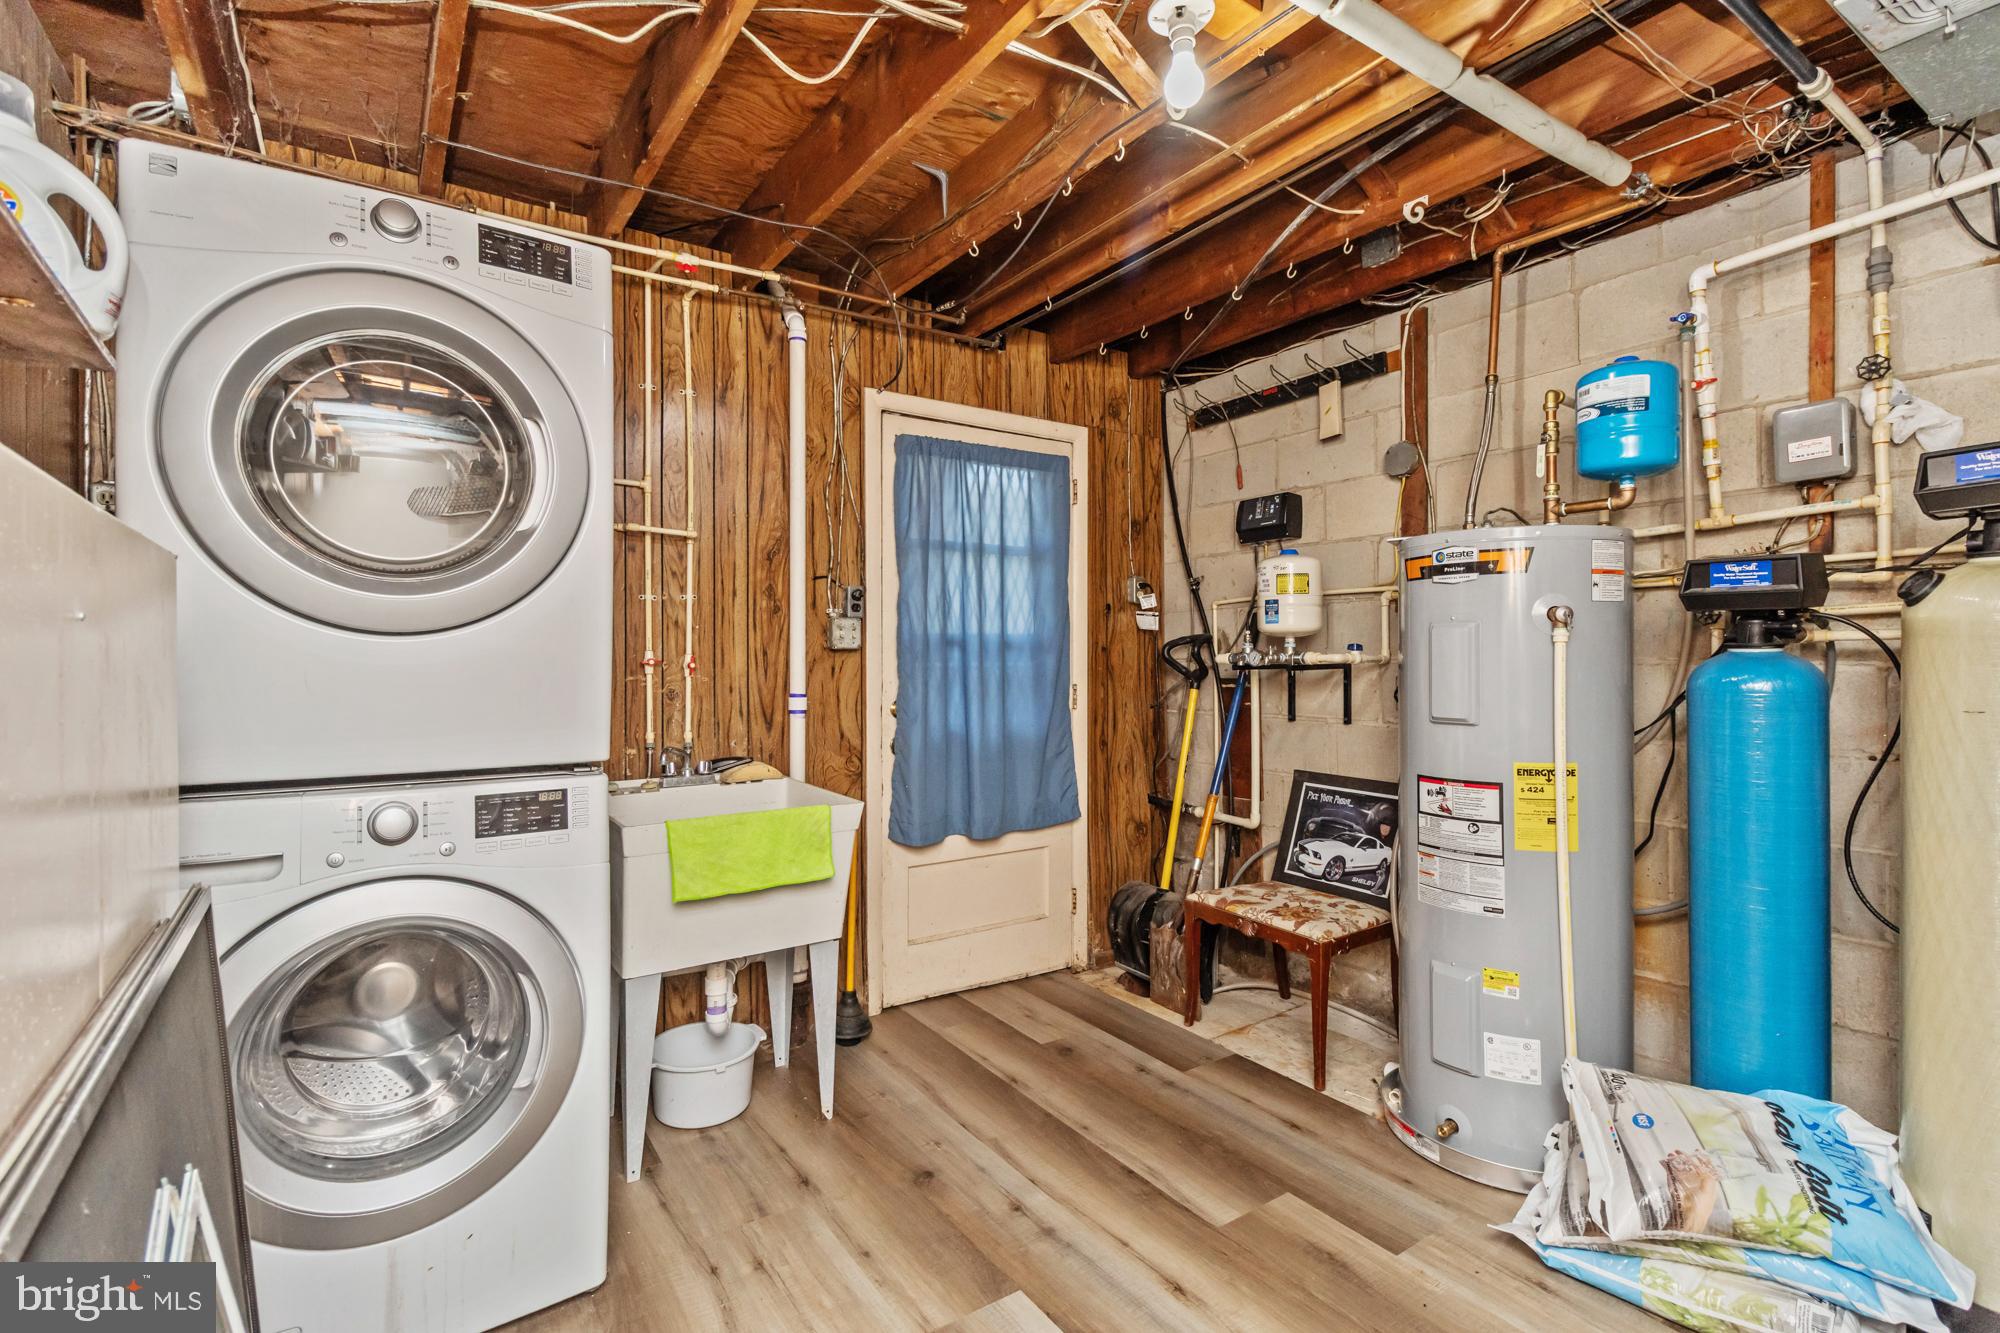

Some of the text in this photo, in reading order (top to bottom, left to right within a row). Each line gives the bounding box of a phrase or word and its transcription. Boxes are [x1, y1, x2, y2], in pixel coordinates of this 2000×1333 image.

[1446, 550, 1474, 558] state
[1352, 876, 1376, 886] SHELBY
[1636, 1114, 1650, 1127] NSF
[1764, 1101, 1802, 1153] olar
[1794, 1160, 1848, 1226] Salt
